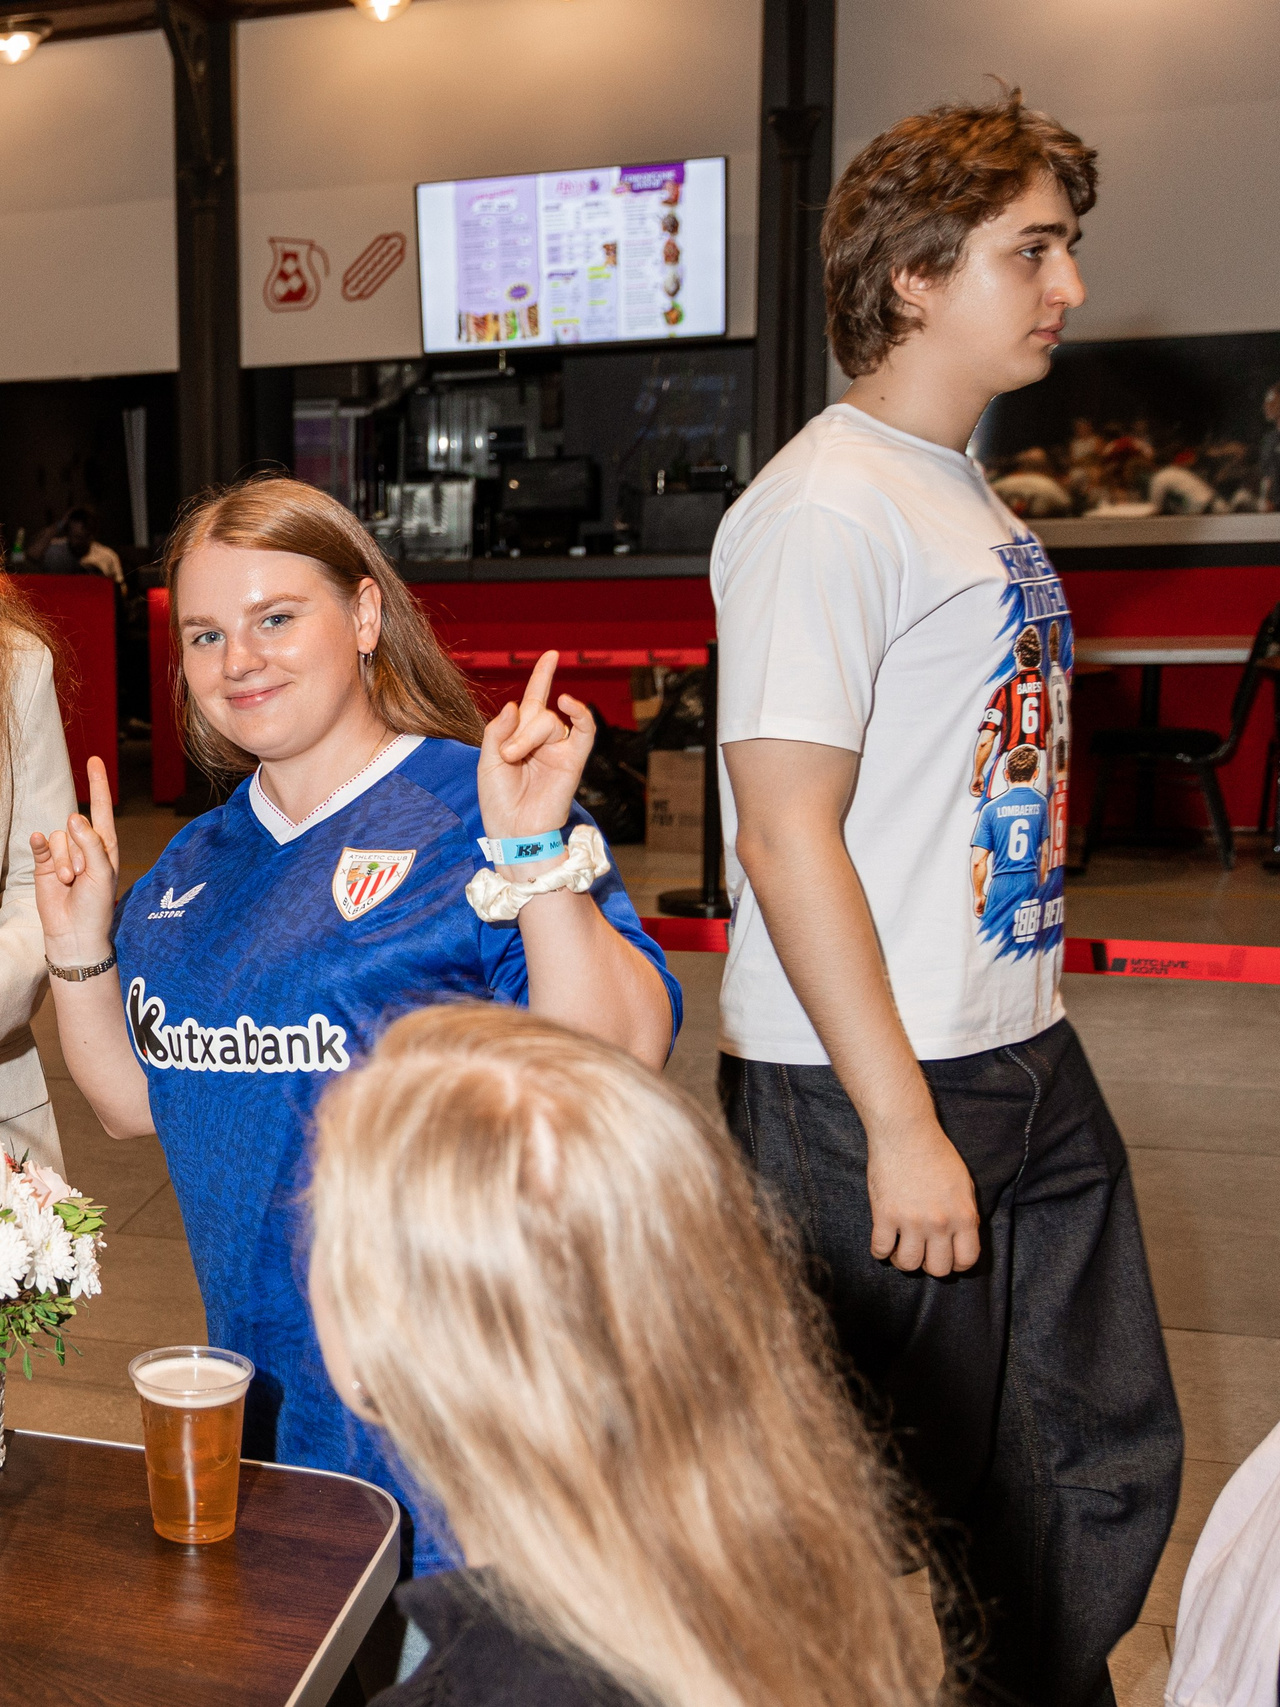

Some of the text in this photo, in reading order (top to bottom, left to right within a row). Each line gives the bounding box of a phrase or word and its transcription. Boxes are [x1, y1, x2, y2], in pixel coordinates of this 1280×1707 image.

[1022, 697, 1038, 734] 6
[997, 804, 1040, 818] LOMBAERTS
[1008, 818, 1030, 860] 6
[147, 910, 186, 920] CASTORE
[342, 897, 374, 915] BILBAO
[130, 982, 342, 1067] Kutxabank
